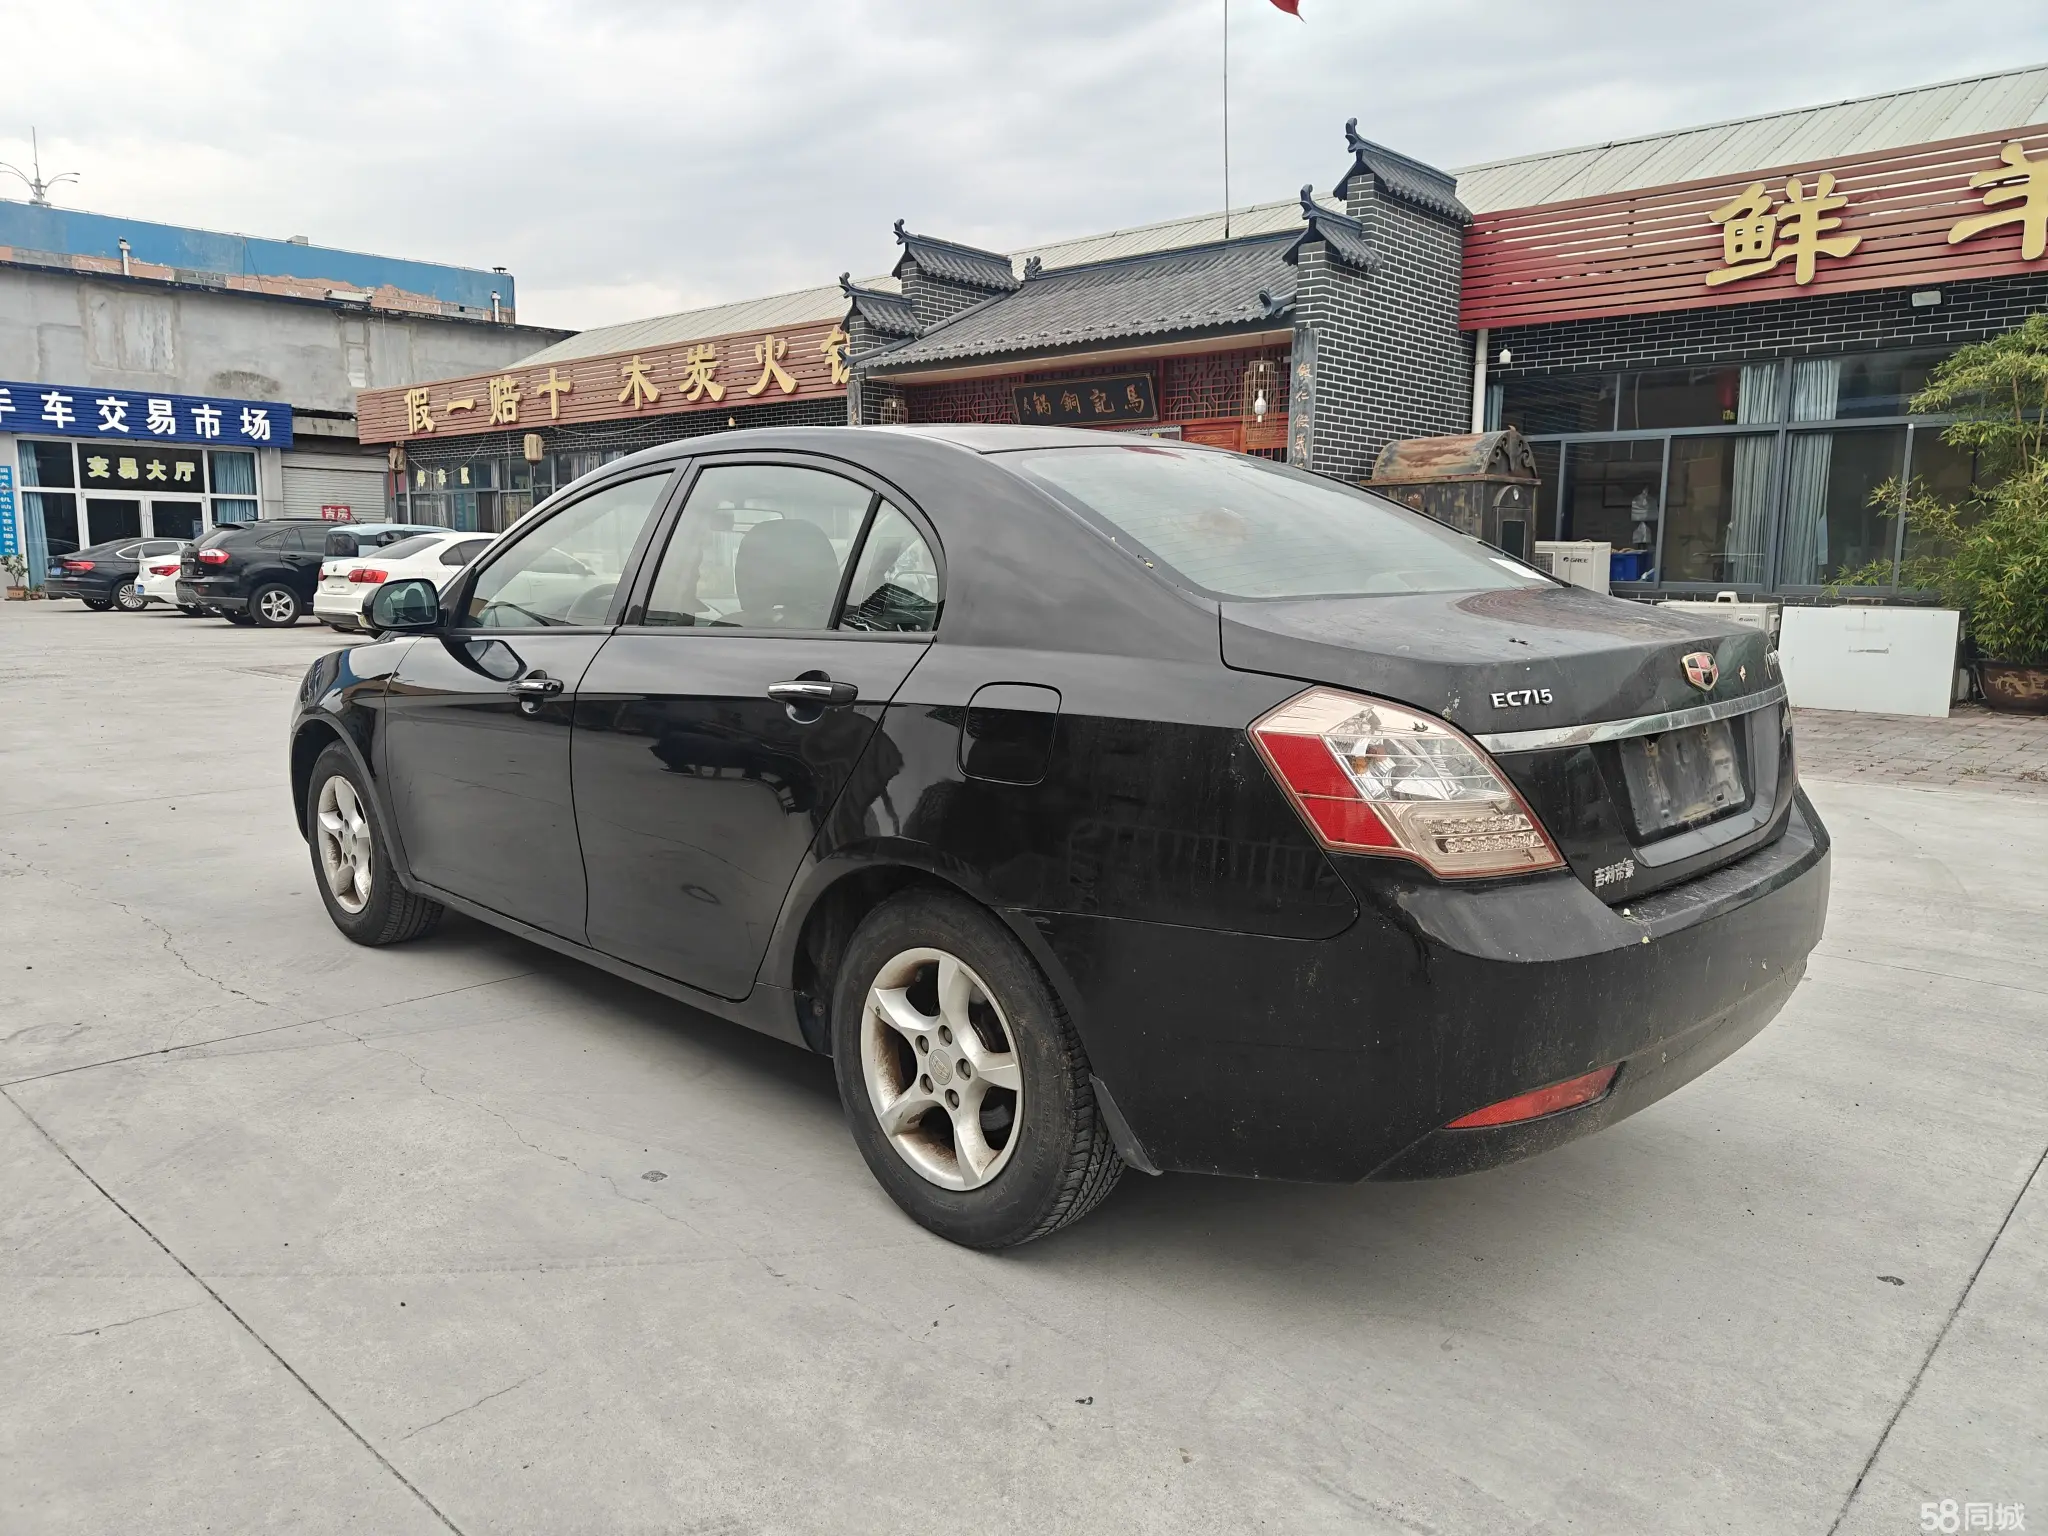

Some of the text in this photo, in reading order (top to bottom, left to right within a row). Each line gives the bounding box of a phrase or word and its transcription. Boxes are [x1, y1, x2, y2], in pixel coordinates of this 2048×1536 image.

[404, 368, 573, 434] 假一赔十
[87, 456, 196, 482] 交易大厅
[1489, 688, 1553, 709] EC715
[1594, 857, 1635, 888] 吉利帝豪
